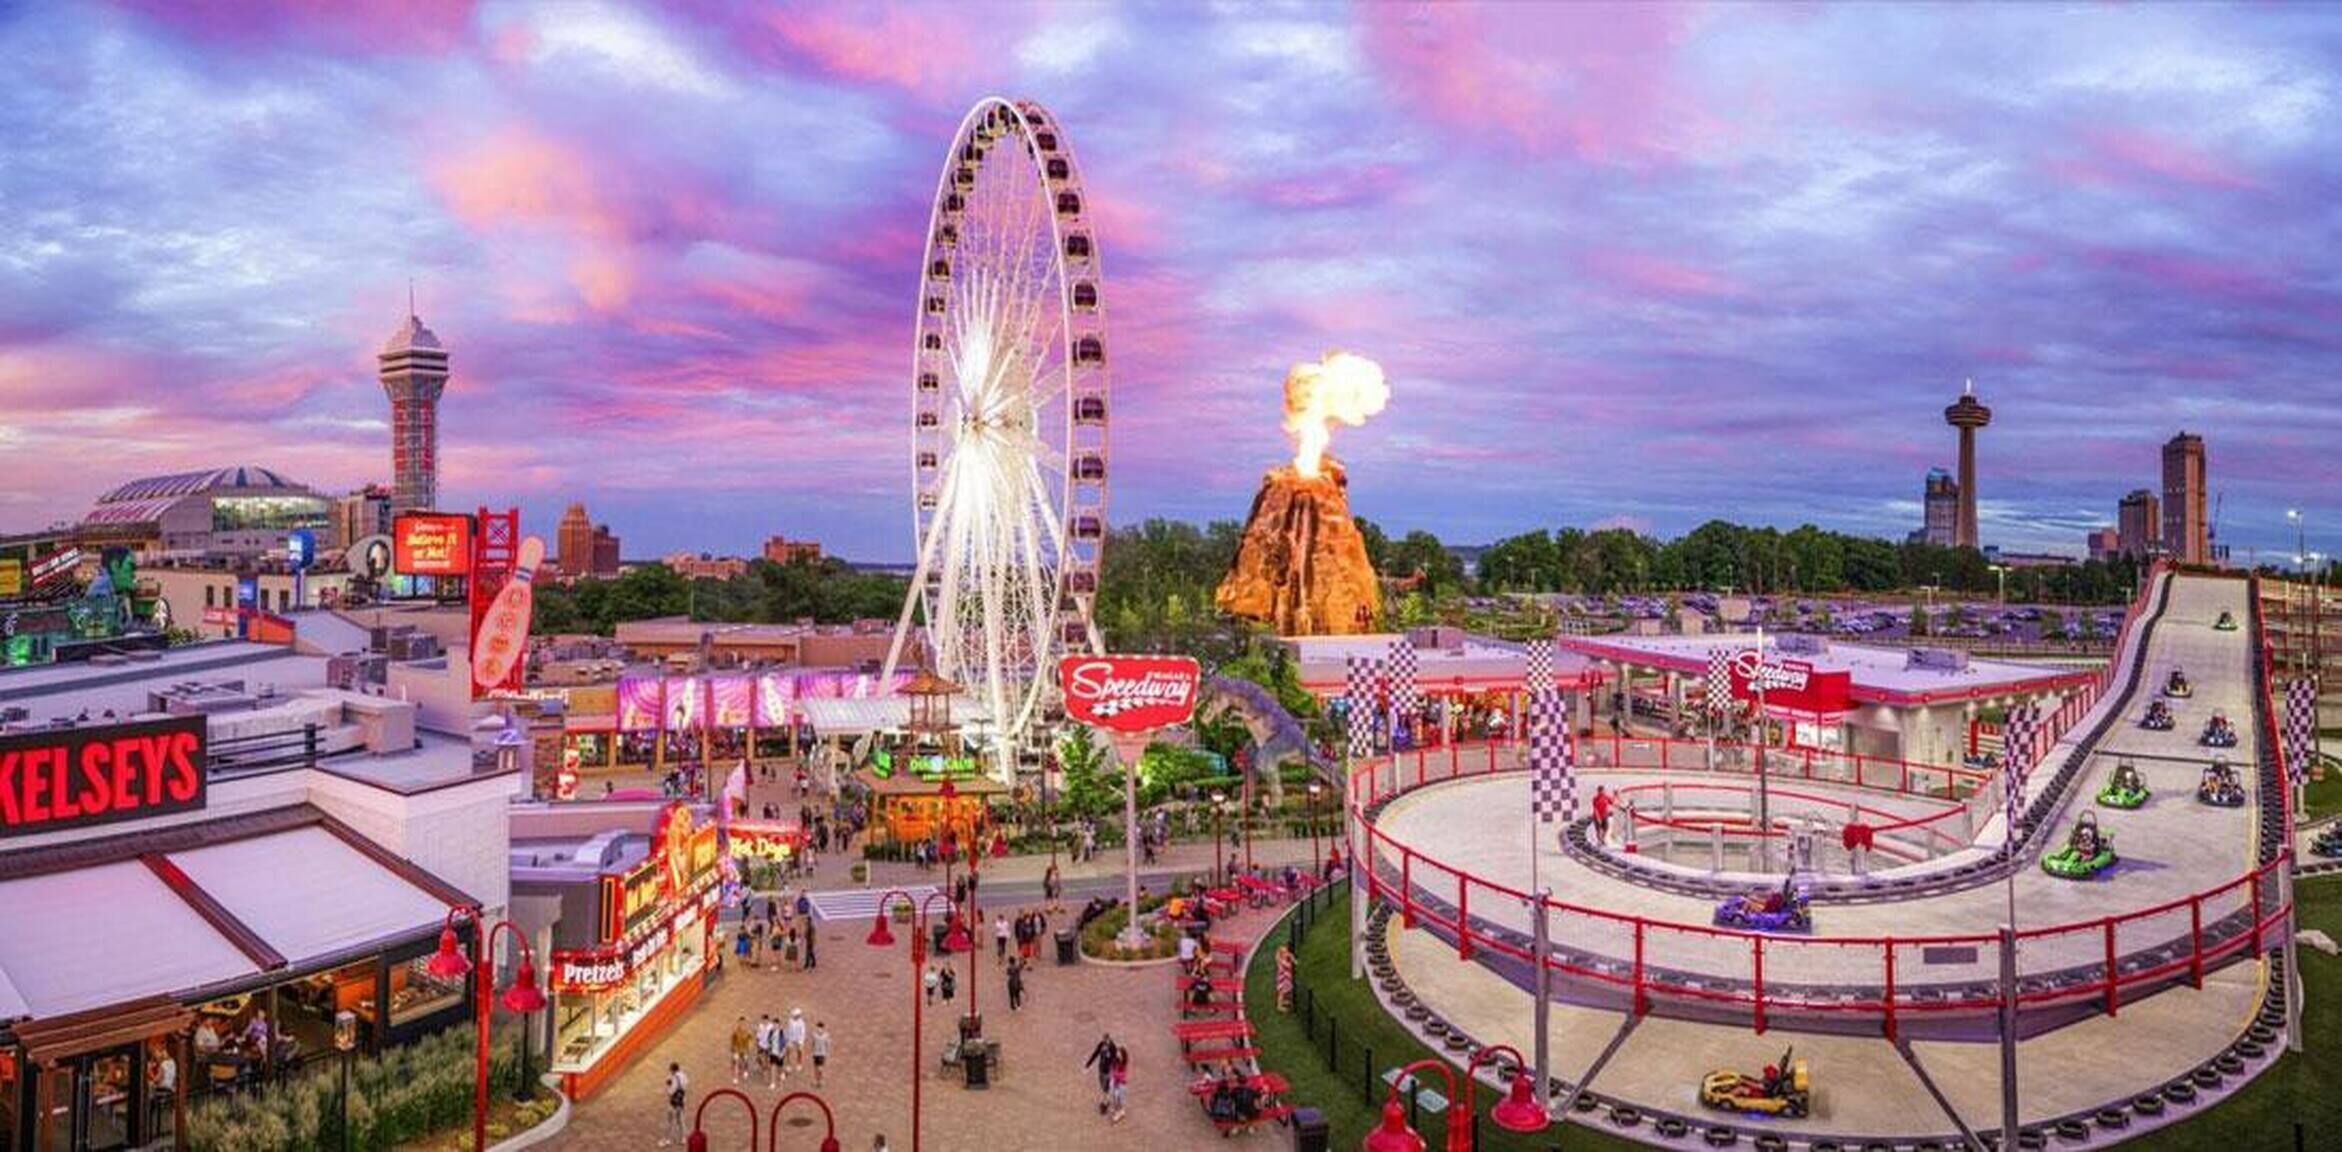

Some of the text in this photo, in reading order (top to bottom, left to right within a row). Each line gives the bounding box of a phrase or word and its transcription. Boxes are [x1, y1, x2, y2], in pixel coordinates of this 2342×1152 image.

[1072, 662, 1191, 706] Speedway
[0, 732, 199, 825] KELSEYS
[730, 838, 753, 858] Hot
[757, 838, 790, 862] Dogs
[563, 959, 624, 984] Pretzels
